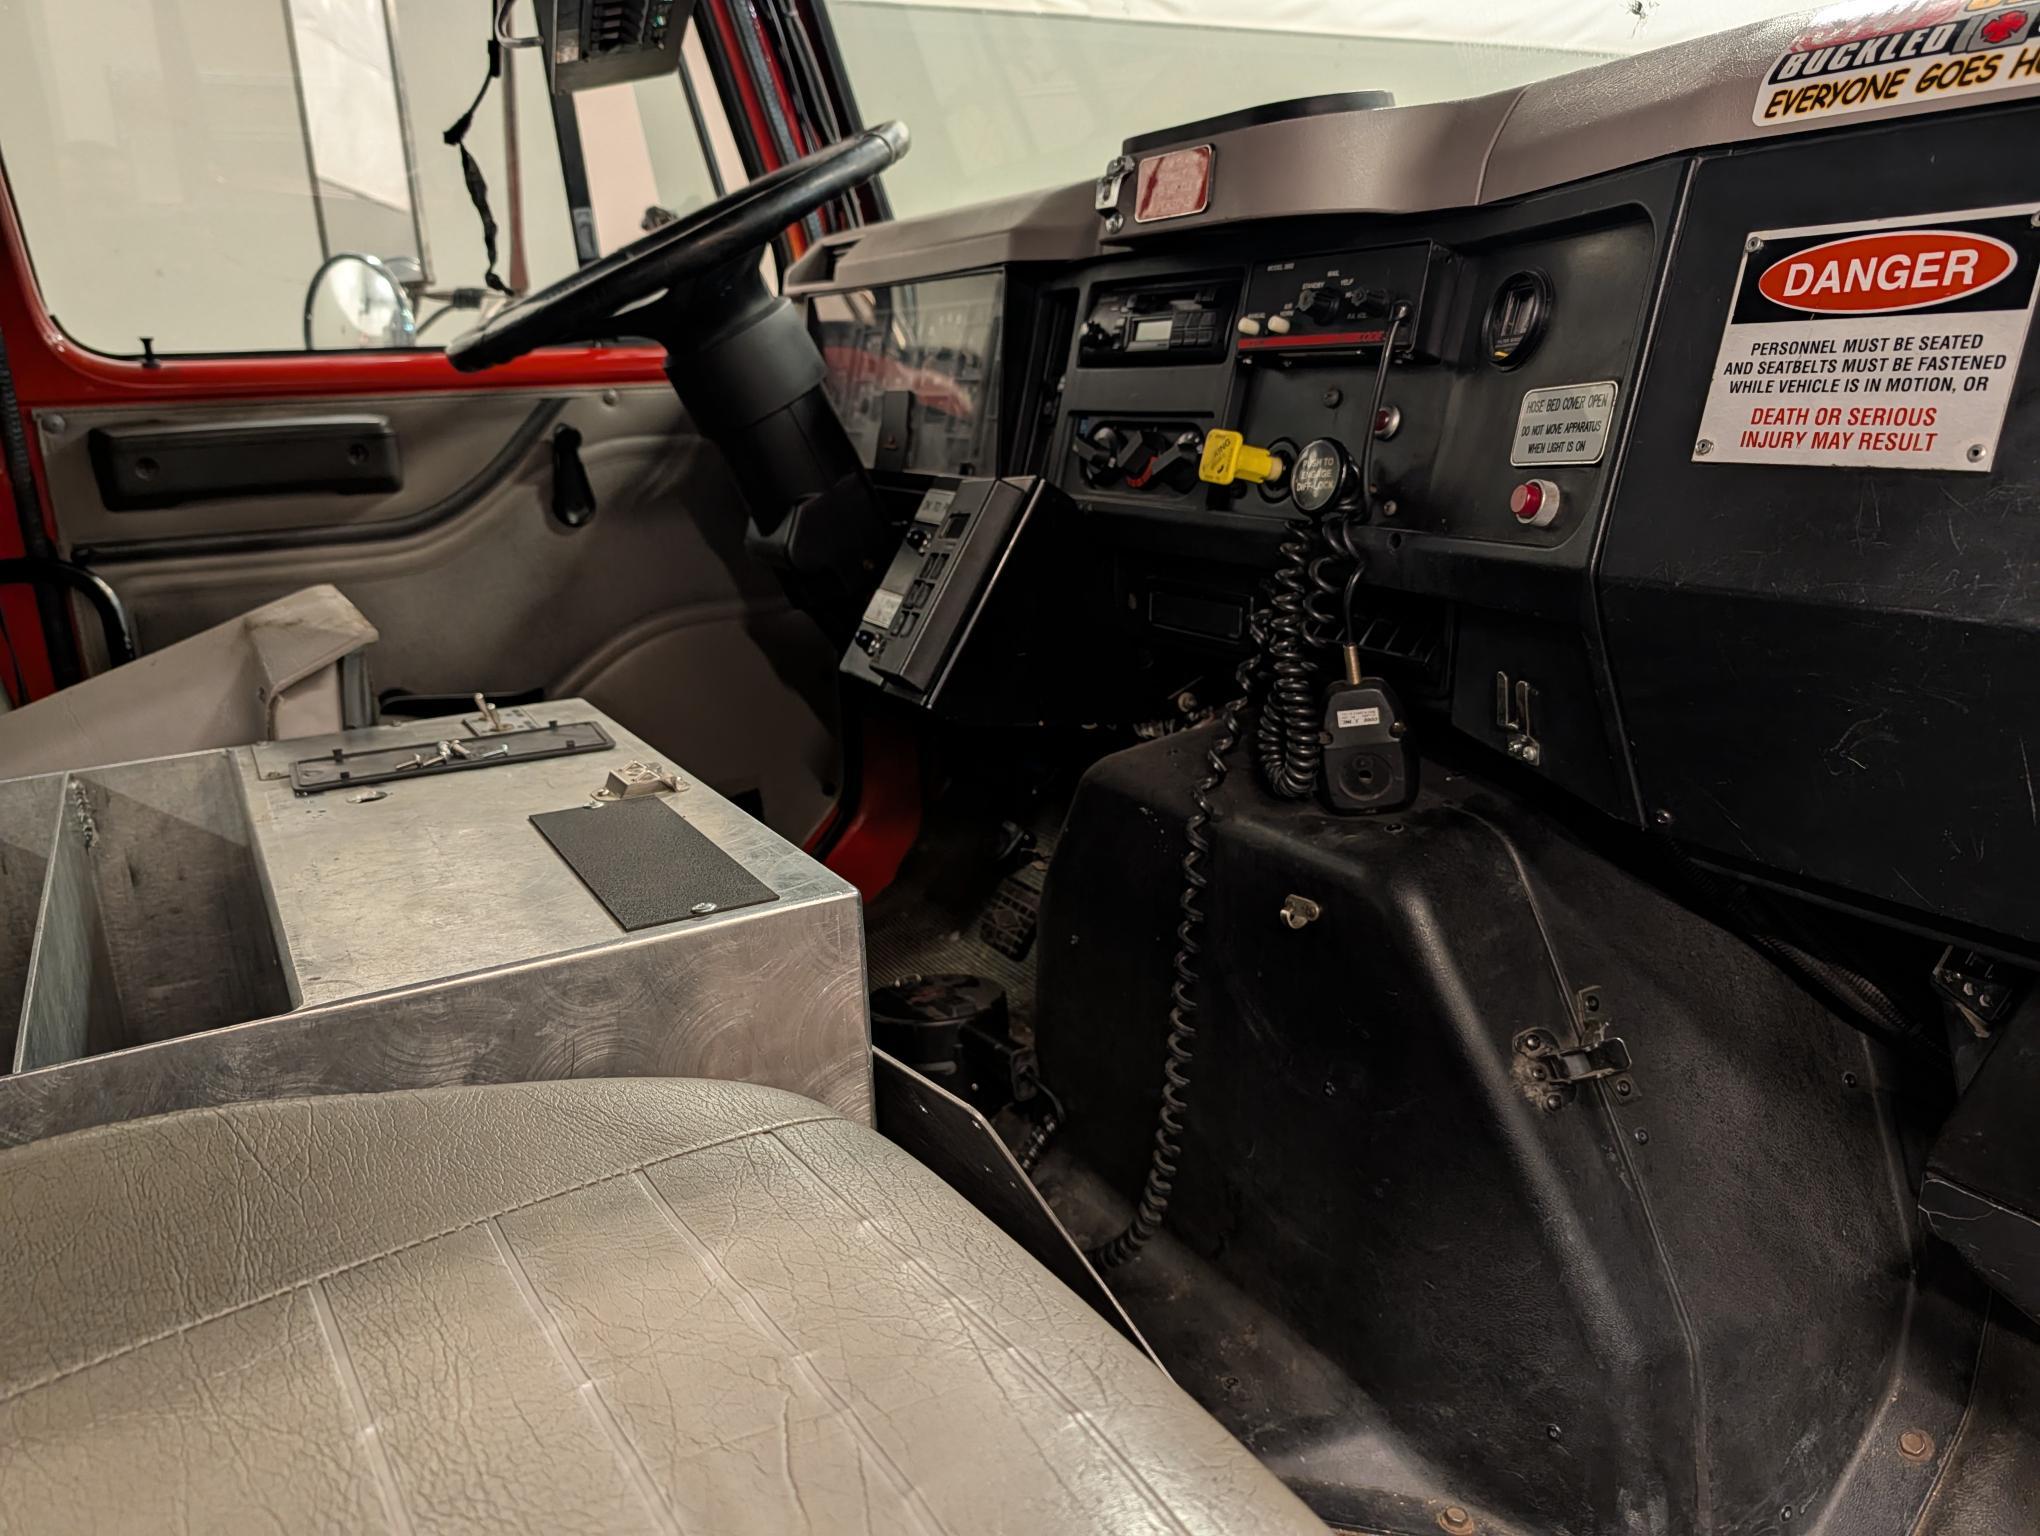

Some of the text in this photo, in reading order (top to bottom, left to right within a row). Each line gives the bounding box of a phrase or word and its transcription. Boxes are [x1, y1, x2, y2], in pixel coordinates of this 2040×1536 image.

[1776, 23, 1957, 81] BUCKLED
[1764, 68, 1911, 119] EVERYONE
[1915, 54, 2004, 93] GOES
[1783, 249, 1979, 297] DANGER
[1750, 334, 1984, 356] PERSONNEL MUST BE SEATED
[1724, 354, 2007, 375] AND SEATBELTS MUST BE FASTENED
[1729, 376, 1989, 394] WHILE VEHICLE IS IN MOTION, OR
[1527, 394, 1608, 413] HOSE BED COVER OPEN
[1750, 407, 1938, 426] DEATH OR SERIOUS
[1521, 421, 1602, 437] DO NOT MOVE APPARATUS
[1528, 440, 1586, 454] WHEN LIGHT IS ON
[1740, 431, 1938, 452] INJURY MAY RESULT
[1324, 457, 1334, 466] TO
